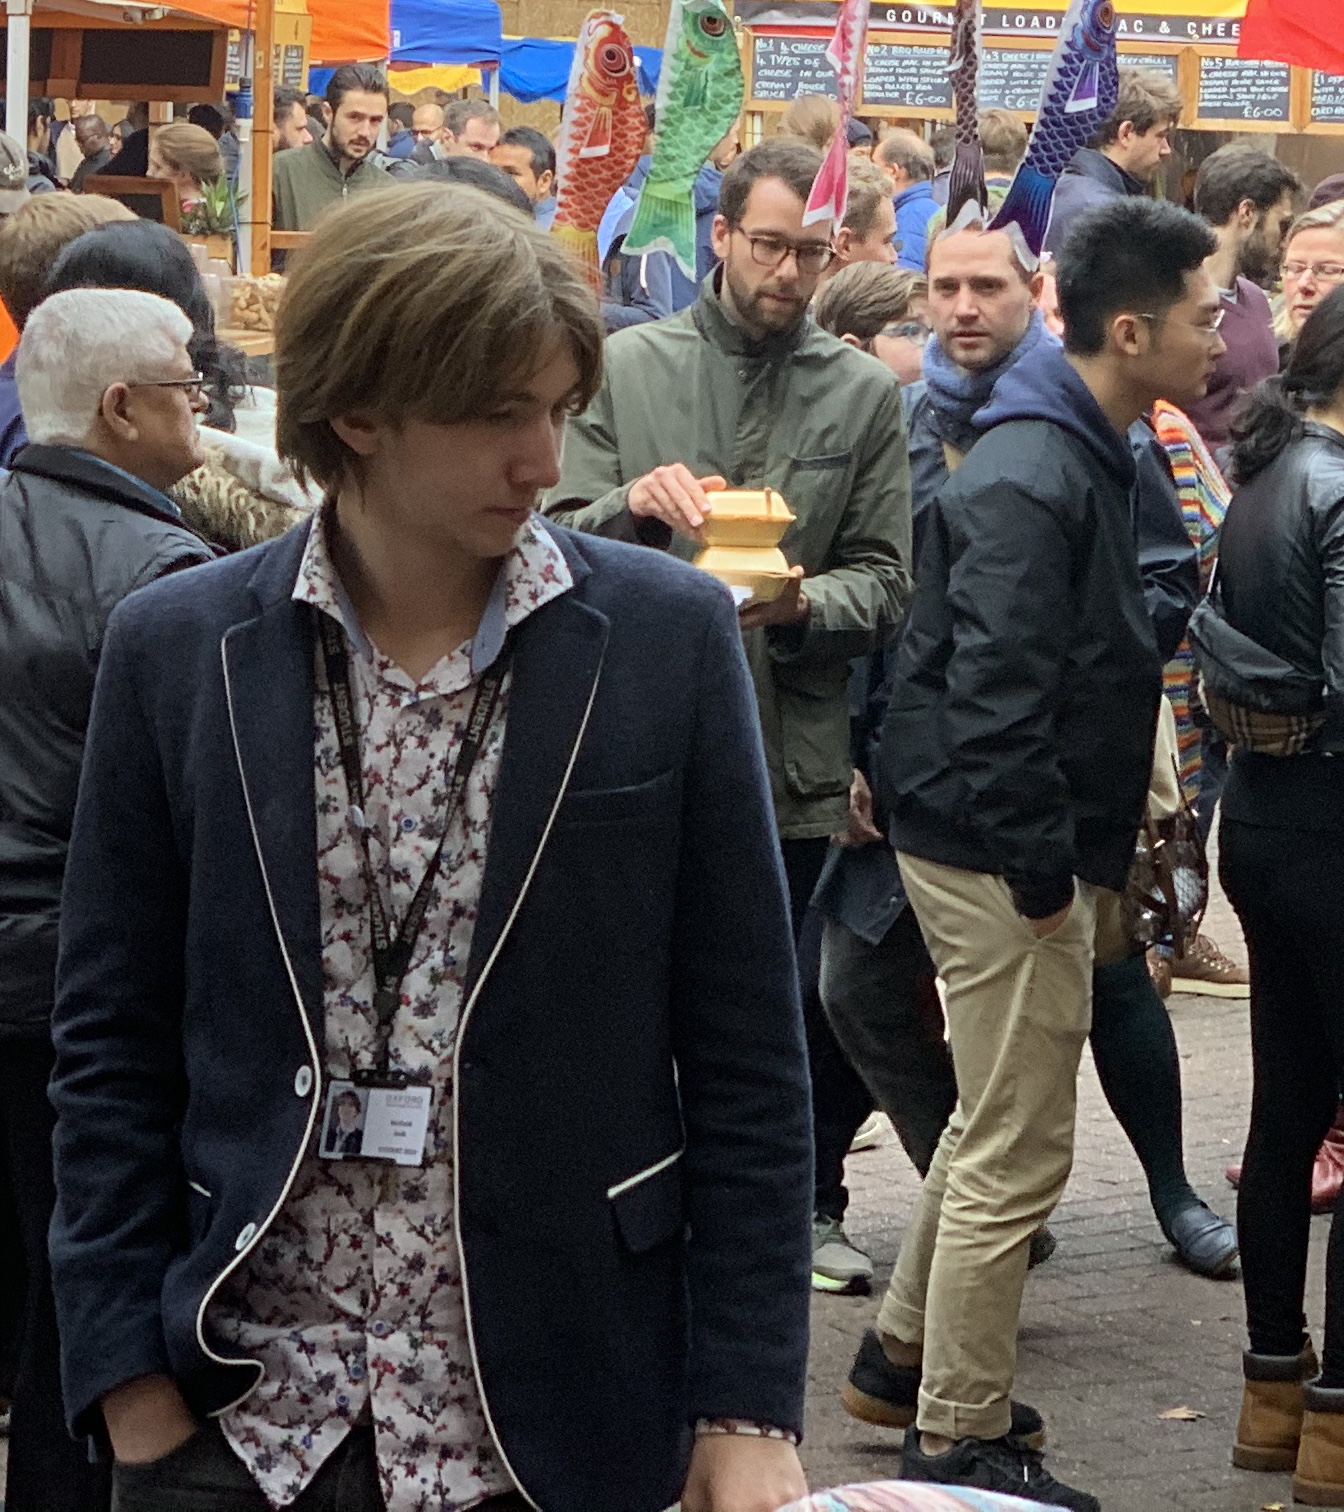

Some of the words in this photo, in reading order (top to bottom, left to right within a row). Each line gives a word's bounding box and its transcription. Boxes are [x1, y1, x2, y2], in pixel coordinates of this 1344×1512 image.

[886, 9, 987, 26] GOURMT
[1003, 14, 1064, 30] LOAD
[1118, 18, 1144, 34] AC
[1159, 20, 1172, 35] &
[1188, 21, 1241, 37] CHEE
[756, 54, 766, 66] 4
[769, 54, 801, 67] TYPES
[804, 58, 821, 68] OF
[799, 69, 812, 77] IN
[467, 678, 497, 744] STUDENT
